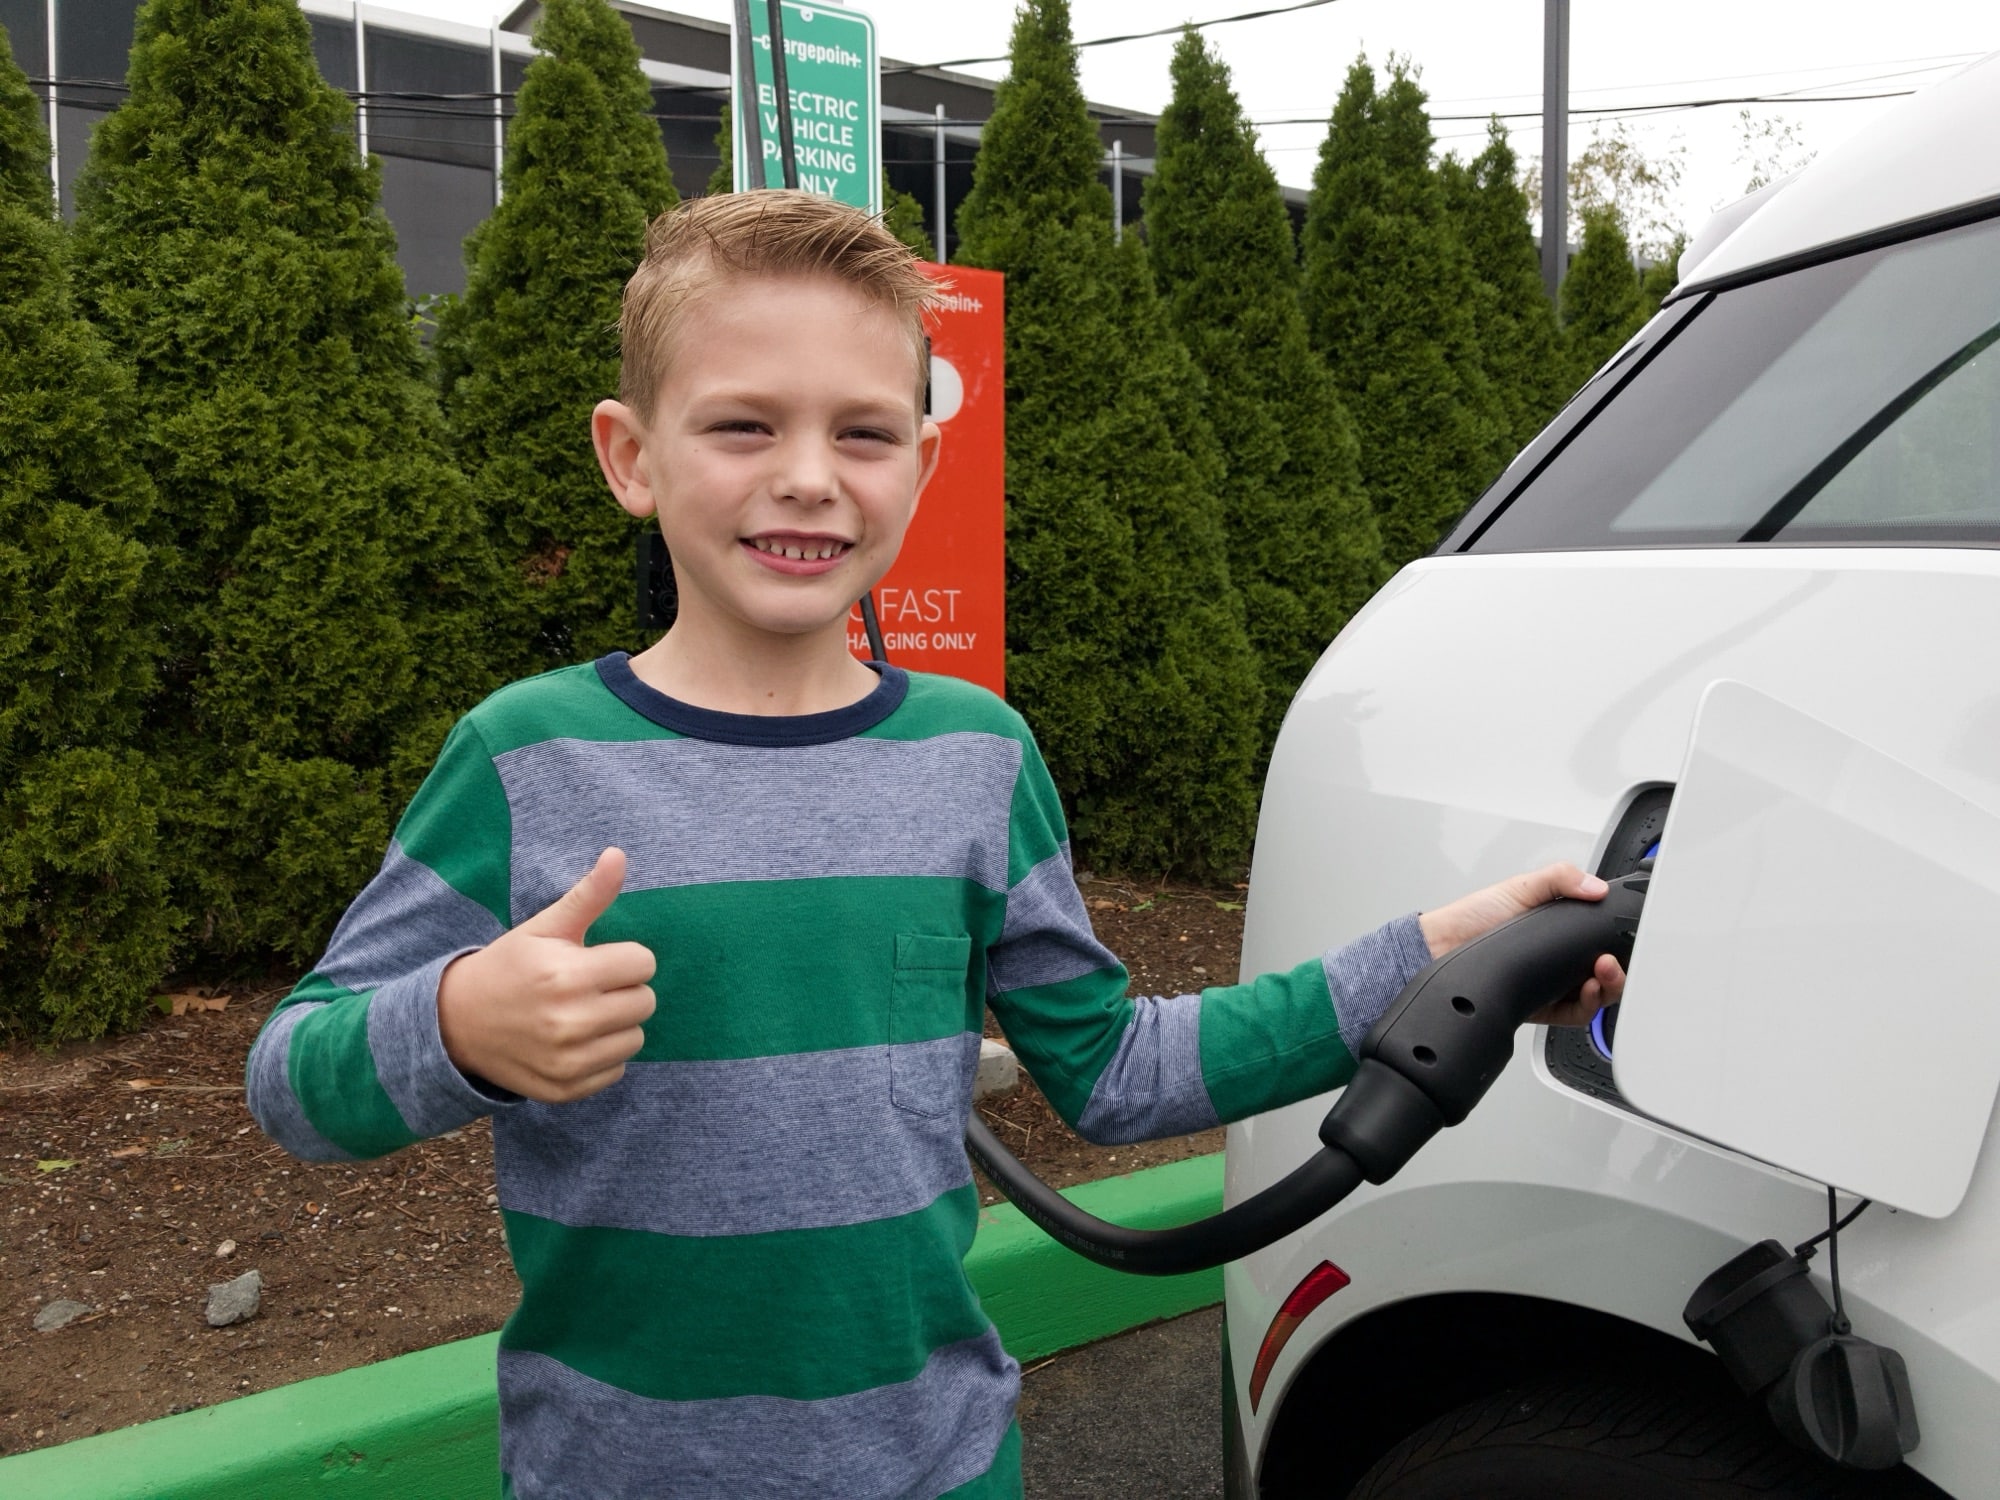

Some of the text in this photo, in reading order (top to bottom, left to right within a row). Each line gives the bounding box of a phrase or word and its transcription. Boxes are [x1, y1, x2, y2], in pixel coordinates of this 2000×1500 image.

[759, 34, 862, 68] cargepoint
[764, 112, 853, 147] VHICLE
[782, 172, 838, 198] NLY
[880, 588, 962, 623] FAST
[846, 632, 976, 650] HAGING ONLY
